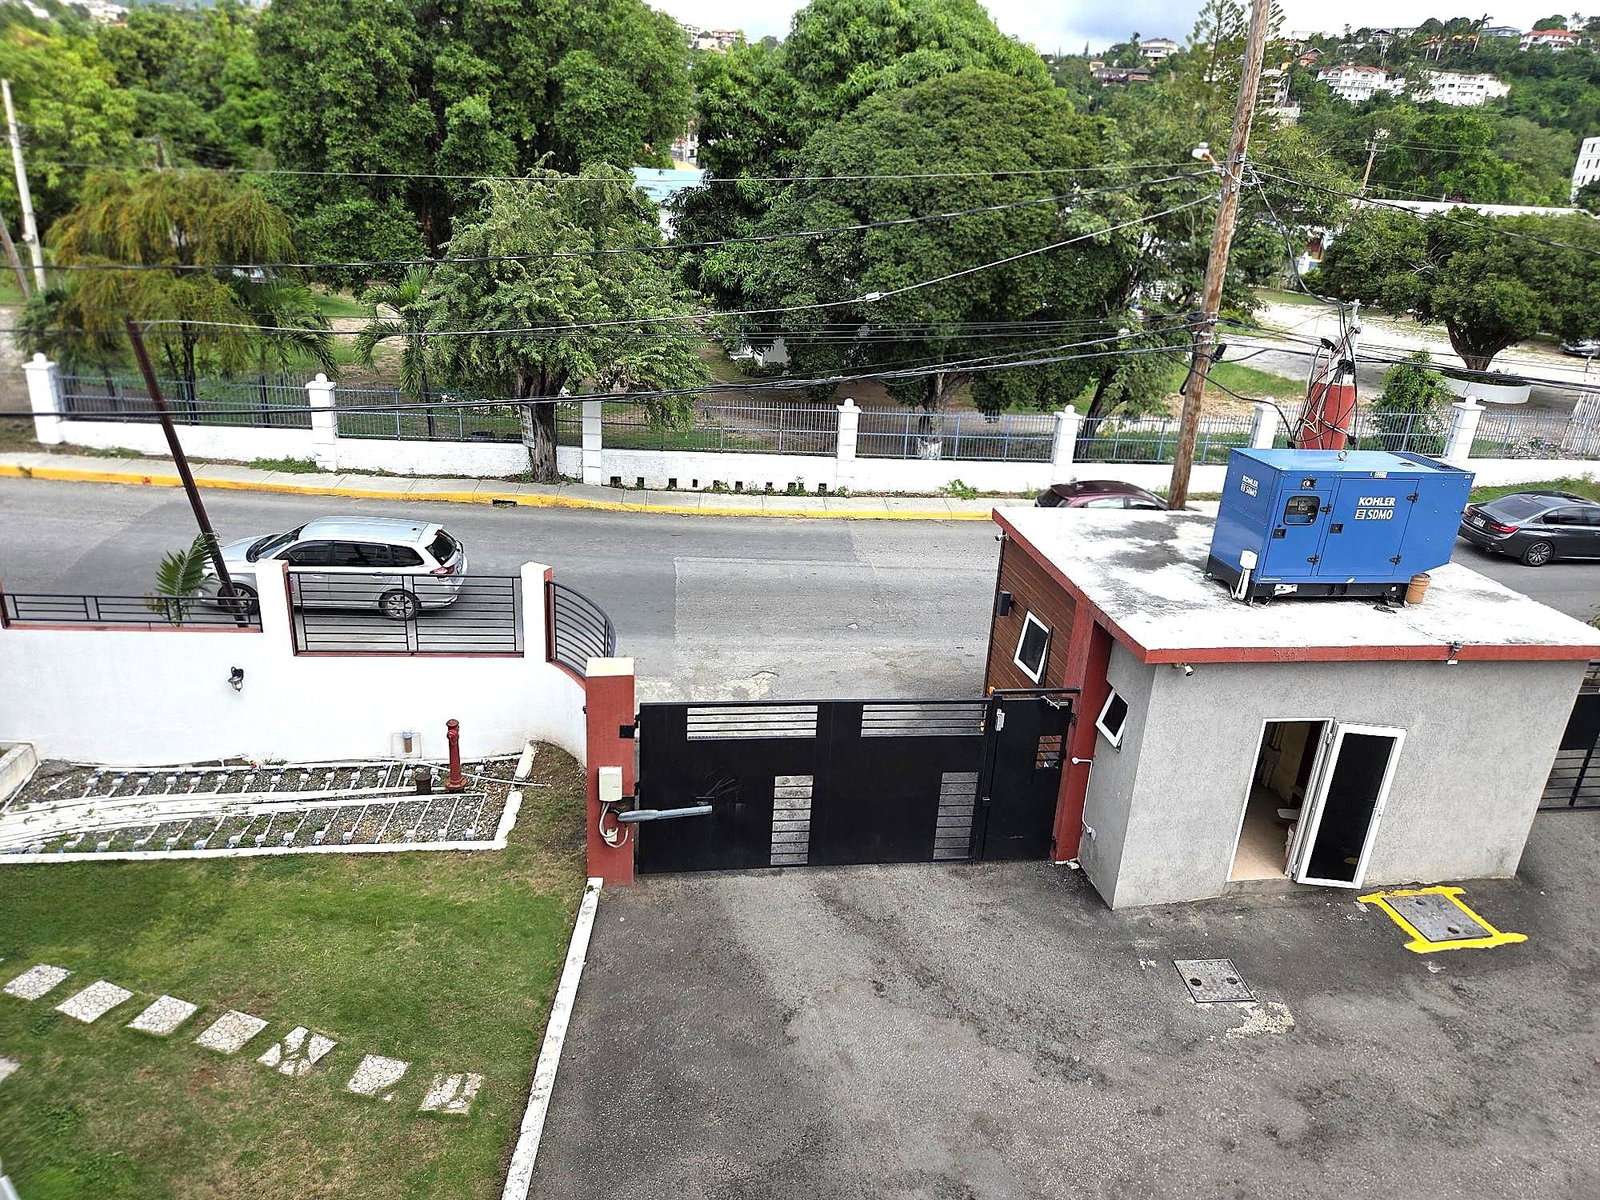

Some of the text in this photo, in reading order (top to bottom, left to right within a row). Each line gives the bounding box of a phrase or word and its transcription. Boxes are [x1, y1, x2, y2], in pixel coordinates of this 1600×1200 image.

[1242, 475, 1259, 488] KOHLER
[1358, 497, 1396, 507] KOHLER
[1366, 509, 1393, 520] SDMO
